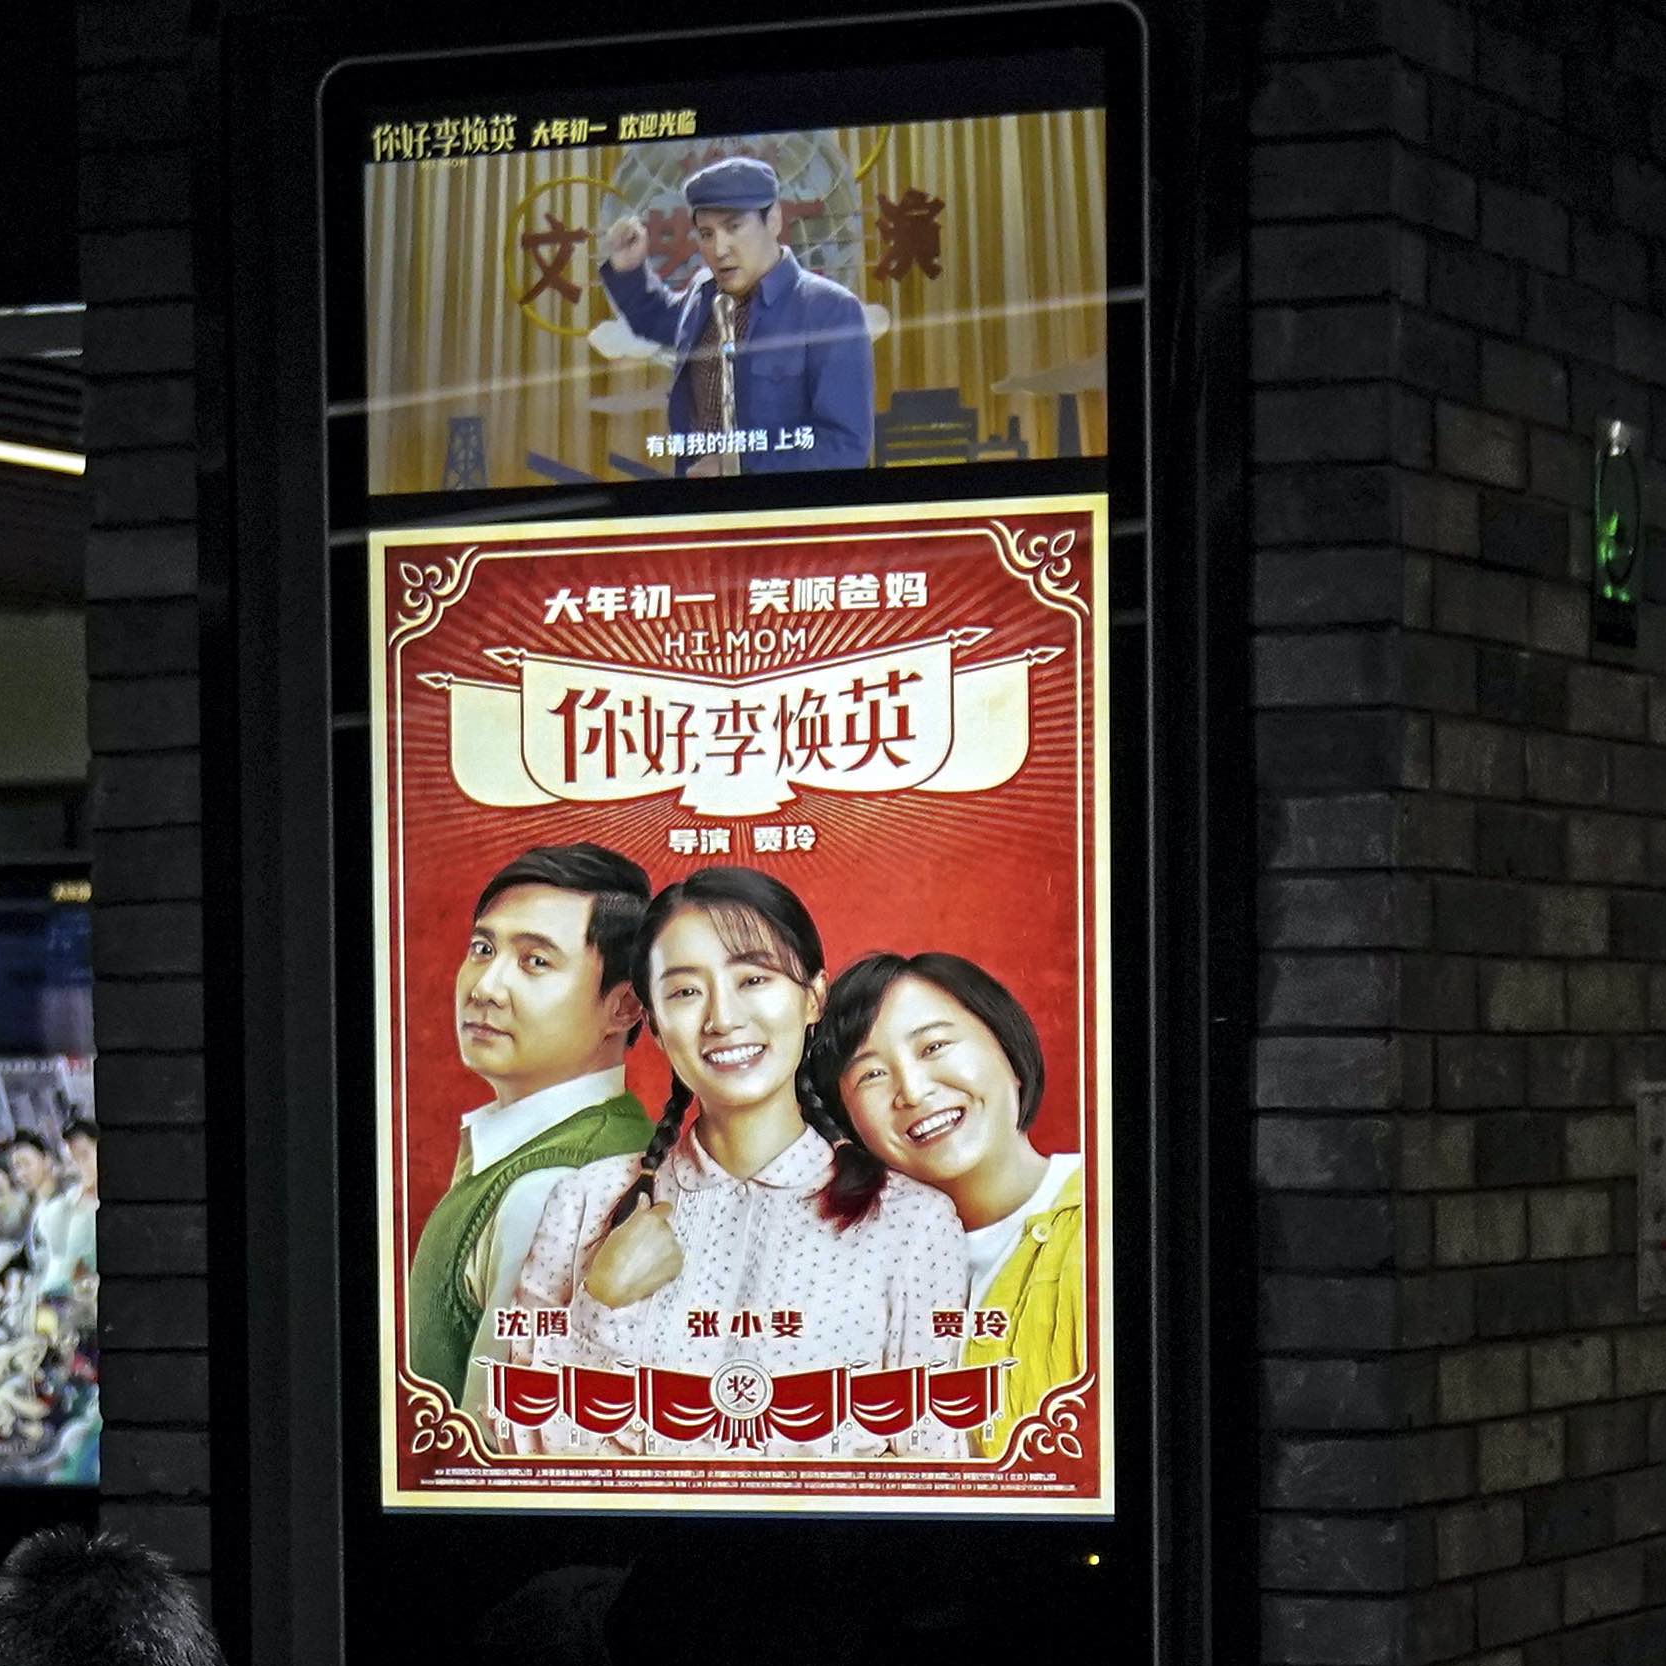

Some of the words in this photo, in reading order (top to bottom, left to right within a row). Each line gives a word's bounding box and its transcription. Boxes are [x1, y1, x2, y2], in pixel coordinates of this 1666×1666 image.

[531, 118, 607, 148] 大年初一
[619, 108, 697, 141] 欢迎光临
[646, 429, 767, 457] 有请我的搭档
[773, 426, 814, 450] 上场
[544, 584, 716, 624] 大年初一
[748, 571, 928, 615] 笑顺爸妈
[668, 827, 731, 855] 导演
[753, 824, 816, 853] 贾玲
[497, 1310, 570, 1337] 沈腾
[686, 1309, 804, 1339] 张小斐
[931, 1310, 1007, 1338] 贾玲
